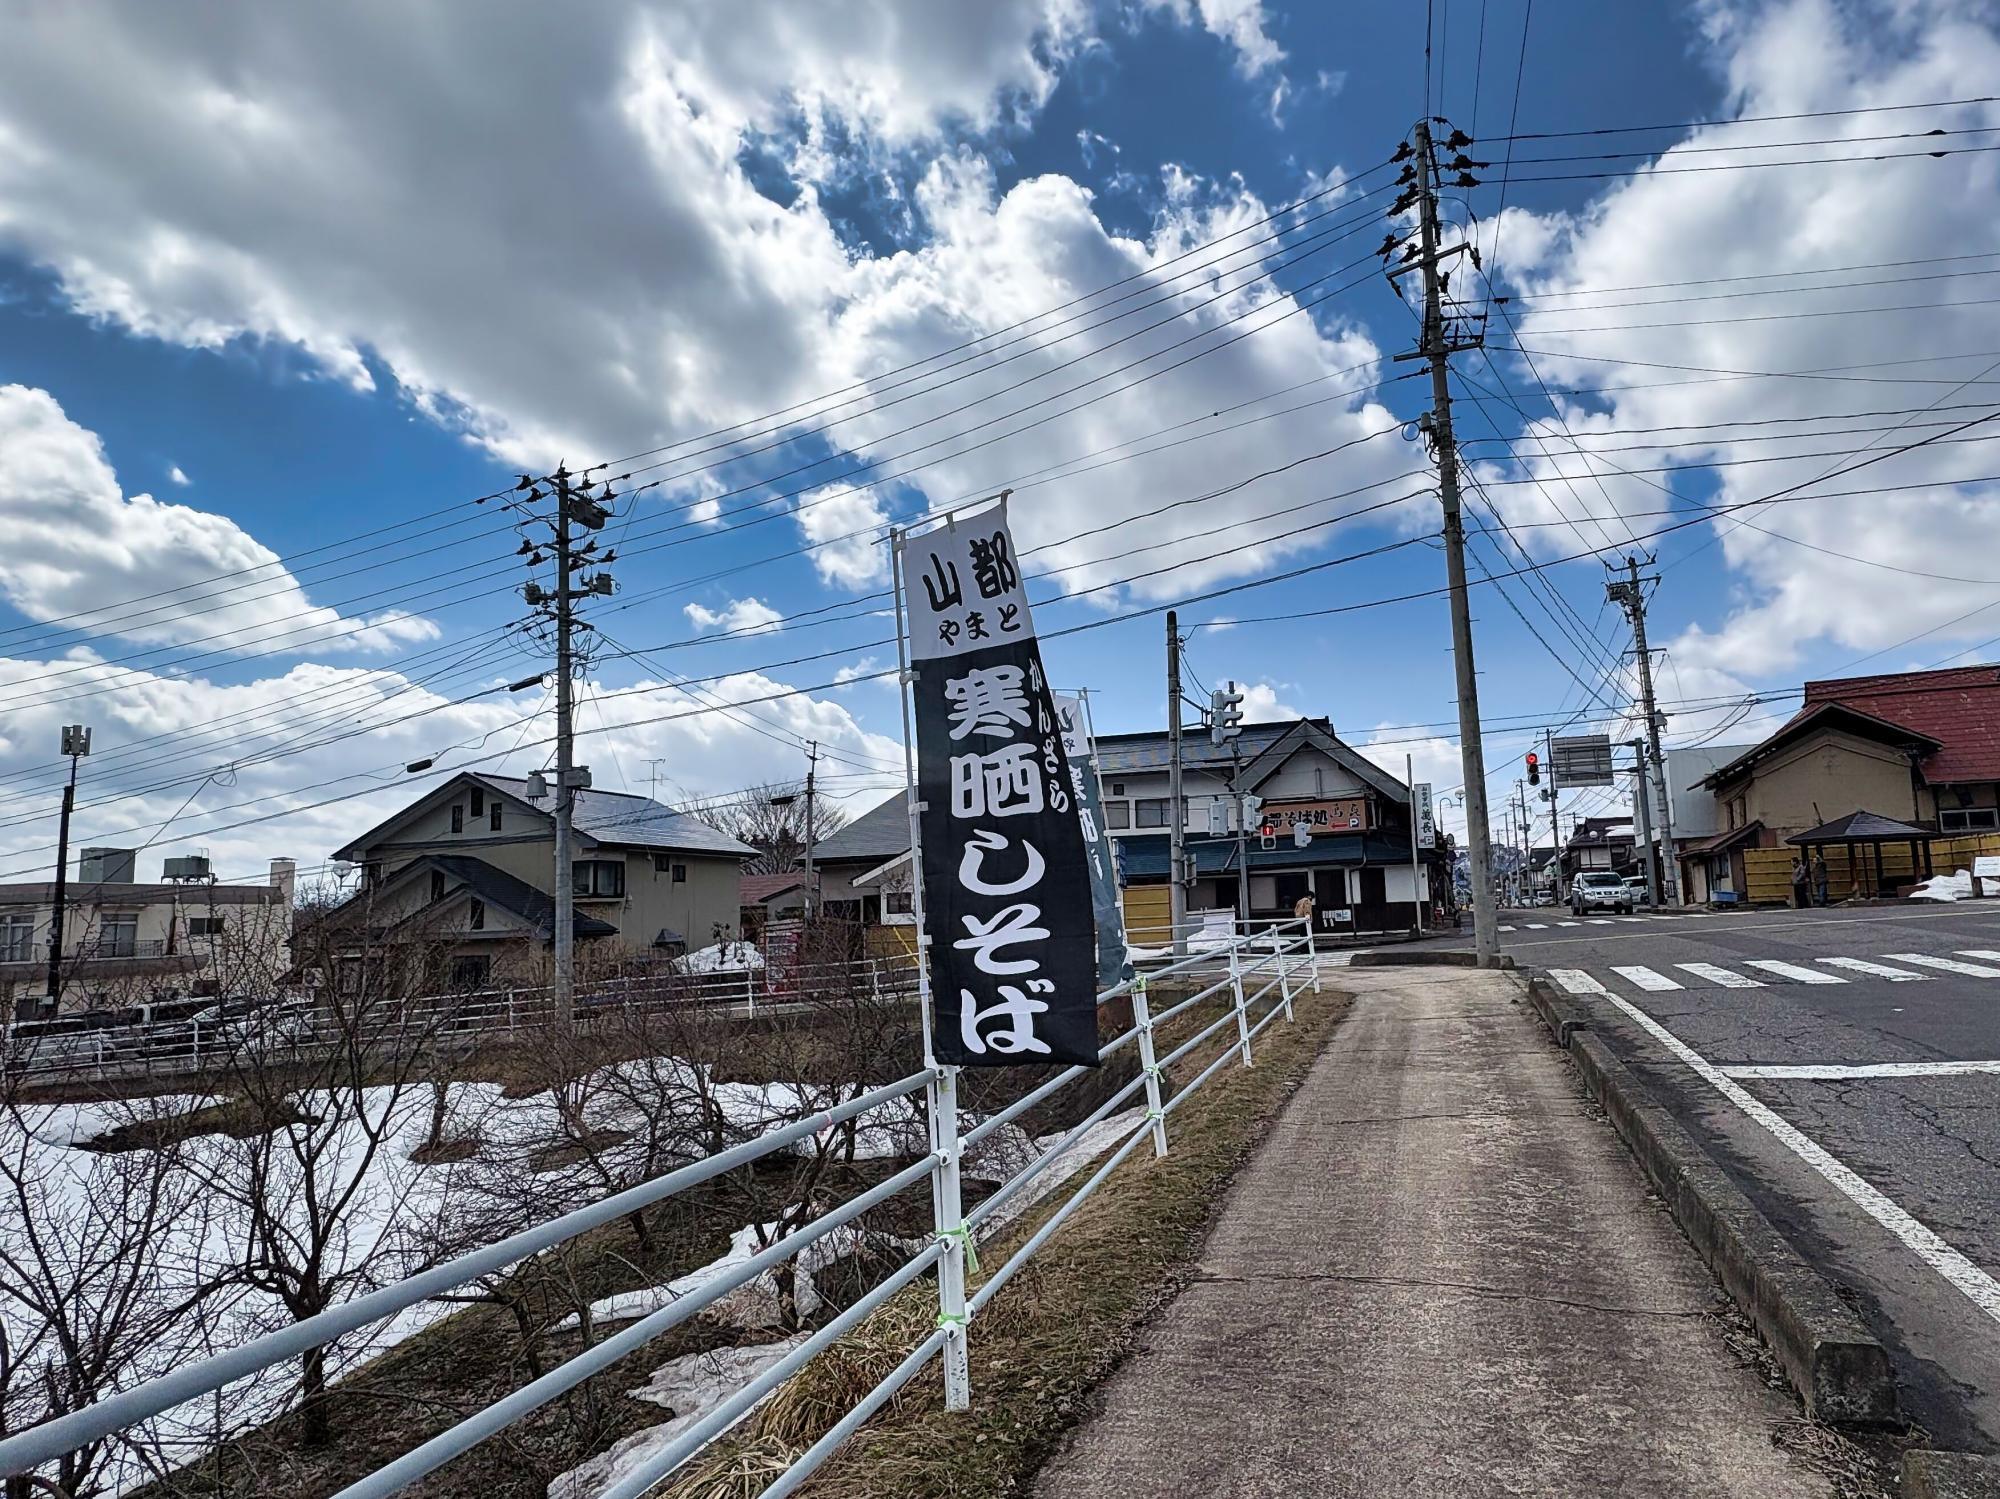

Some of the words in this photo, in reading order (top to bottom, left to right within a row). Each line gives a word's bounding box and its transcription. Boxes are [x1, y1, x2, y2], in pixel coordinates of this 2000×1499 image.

[922, 530, 1016, 613] 山都
[939, 603, 1021, 646] やまと
[945, 664, 1056, 1055] 寒晒しそば
